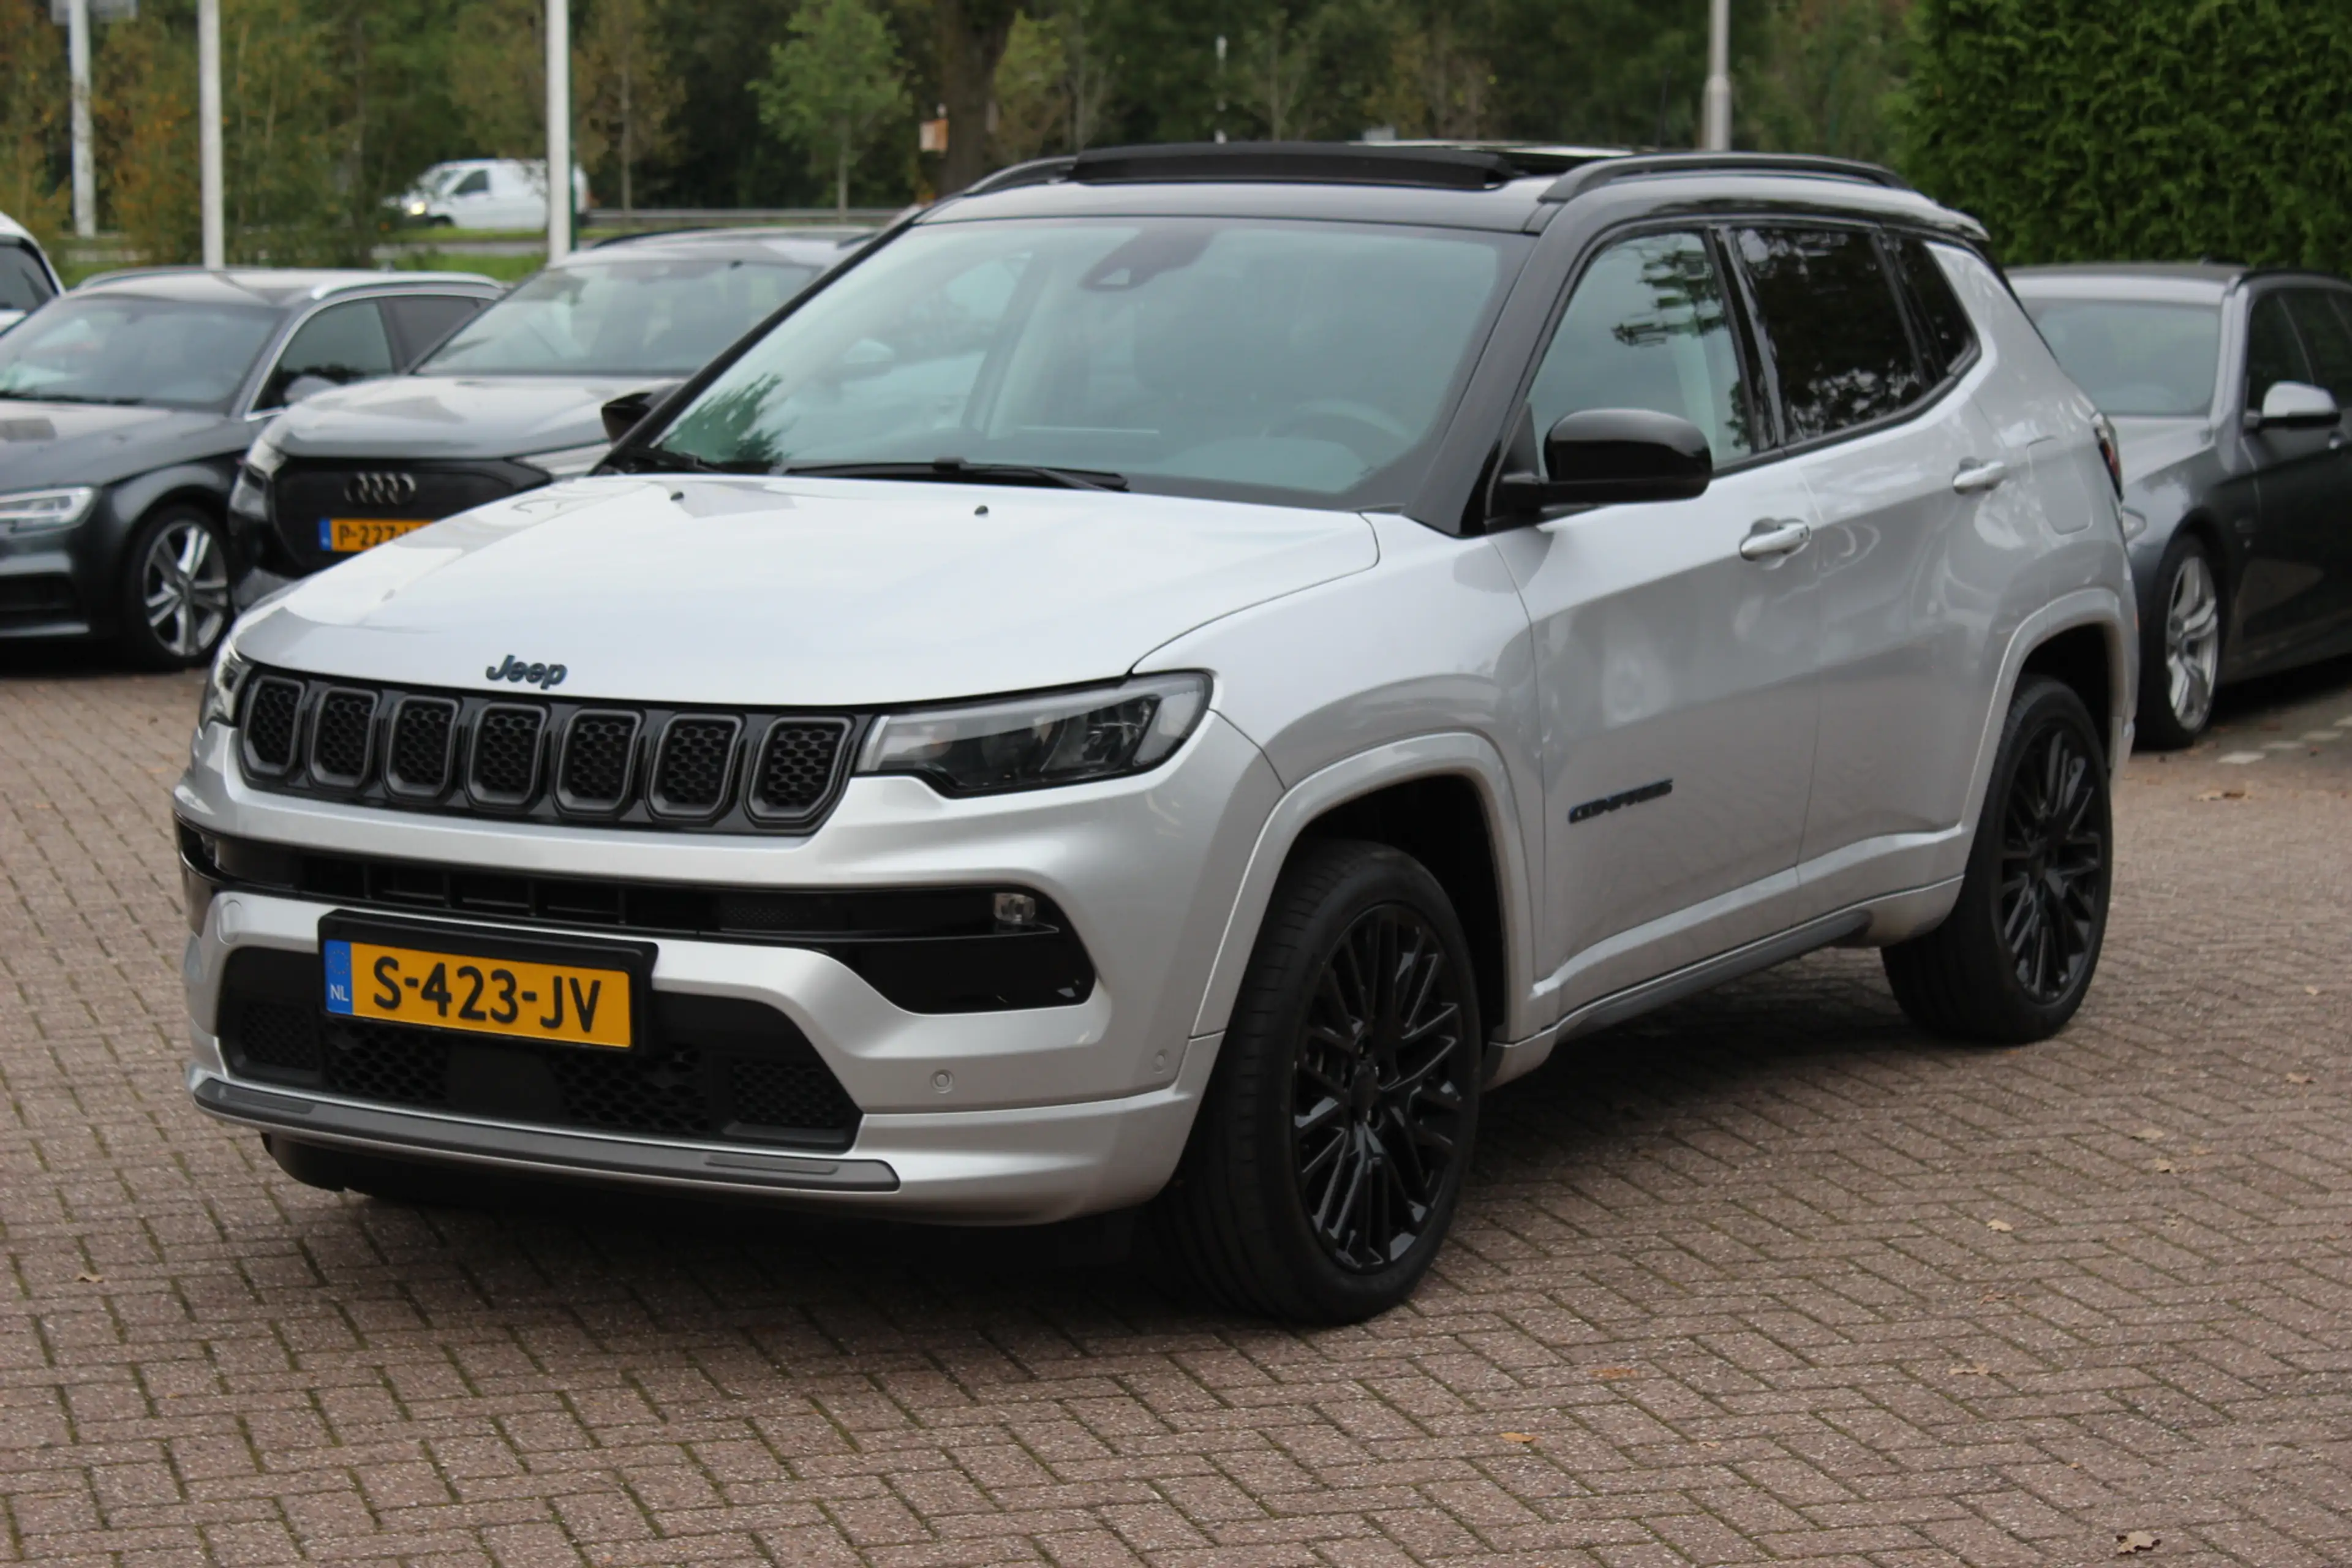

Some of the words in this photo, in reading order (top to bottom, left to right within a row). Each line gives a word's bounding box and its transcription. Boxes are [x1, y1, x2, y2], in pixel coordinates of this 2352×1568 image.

[339, 524, 411, 547] P-227-
[486, 654, 568, 690] Jeep
[330, 984, 349, 1002] NL
[373, 956, 601, 1033] S-423-JV
